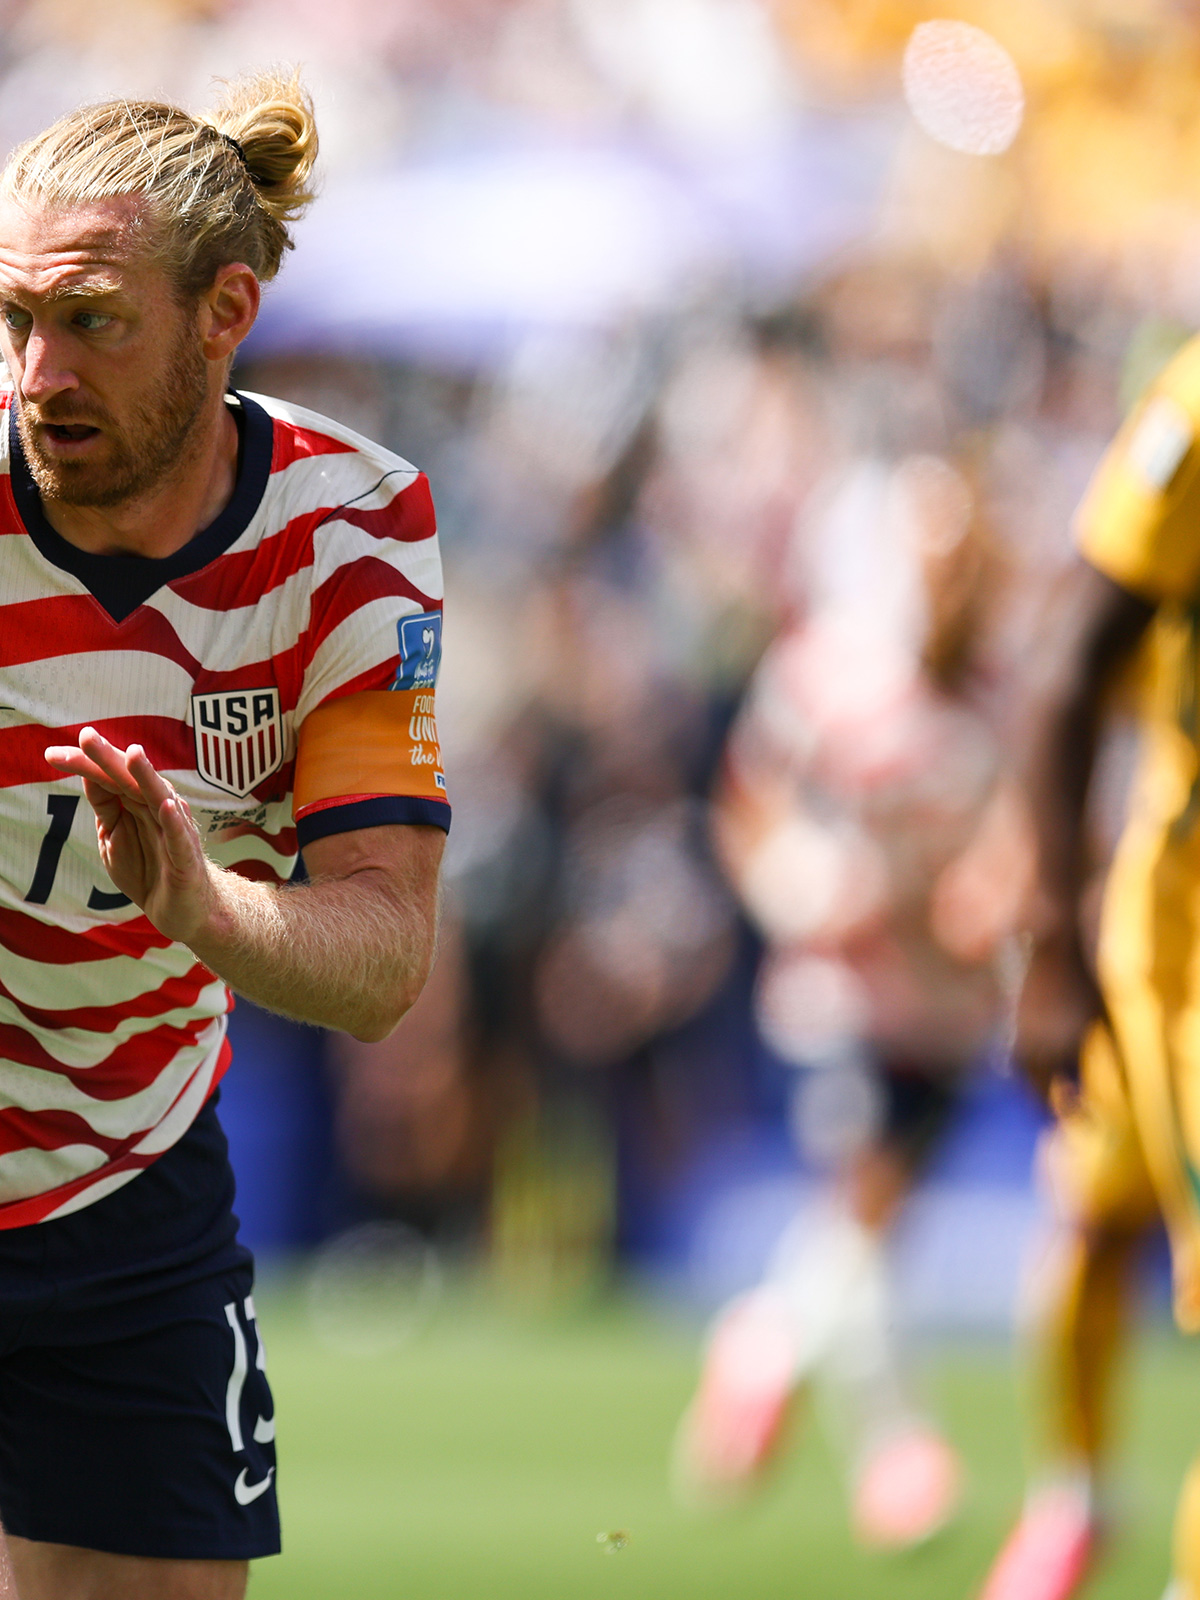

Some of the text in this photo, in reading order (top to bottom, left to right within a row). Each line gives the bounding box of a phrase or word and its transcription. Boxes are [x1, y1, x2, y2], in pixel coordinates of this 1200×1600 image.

[199, 693, 274, 736] USA
[408, 743, 436, 766] the
[24, 794, 133, 911] 1
[223, 1294, 276, 1453] 13
